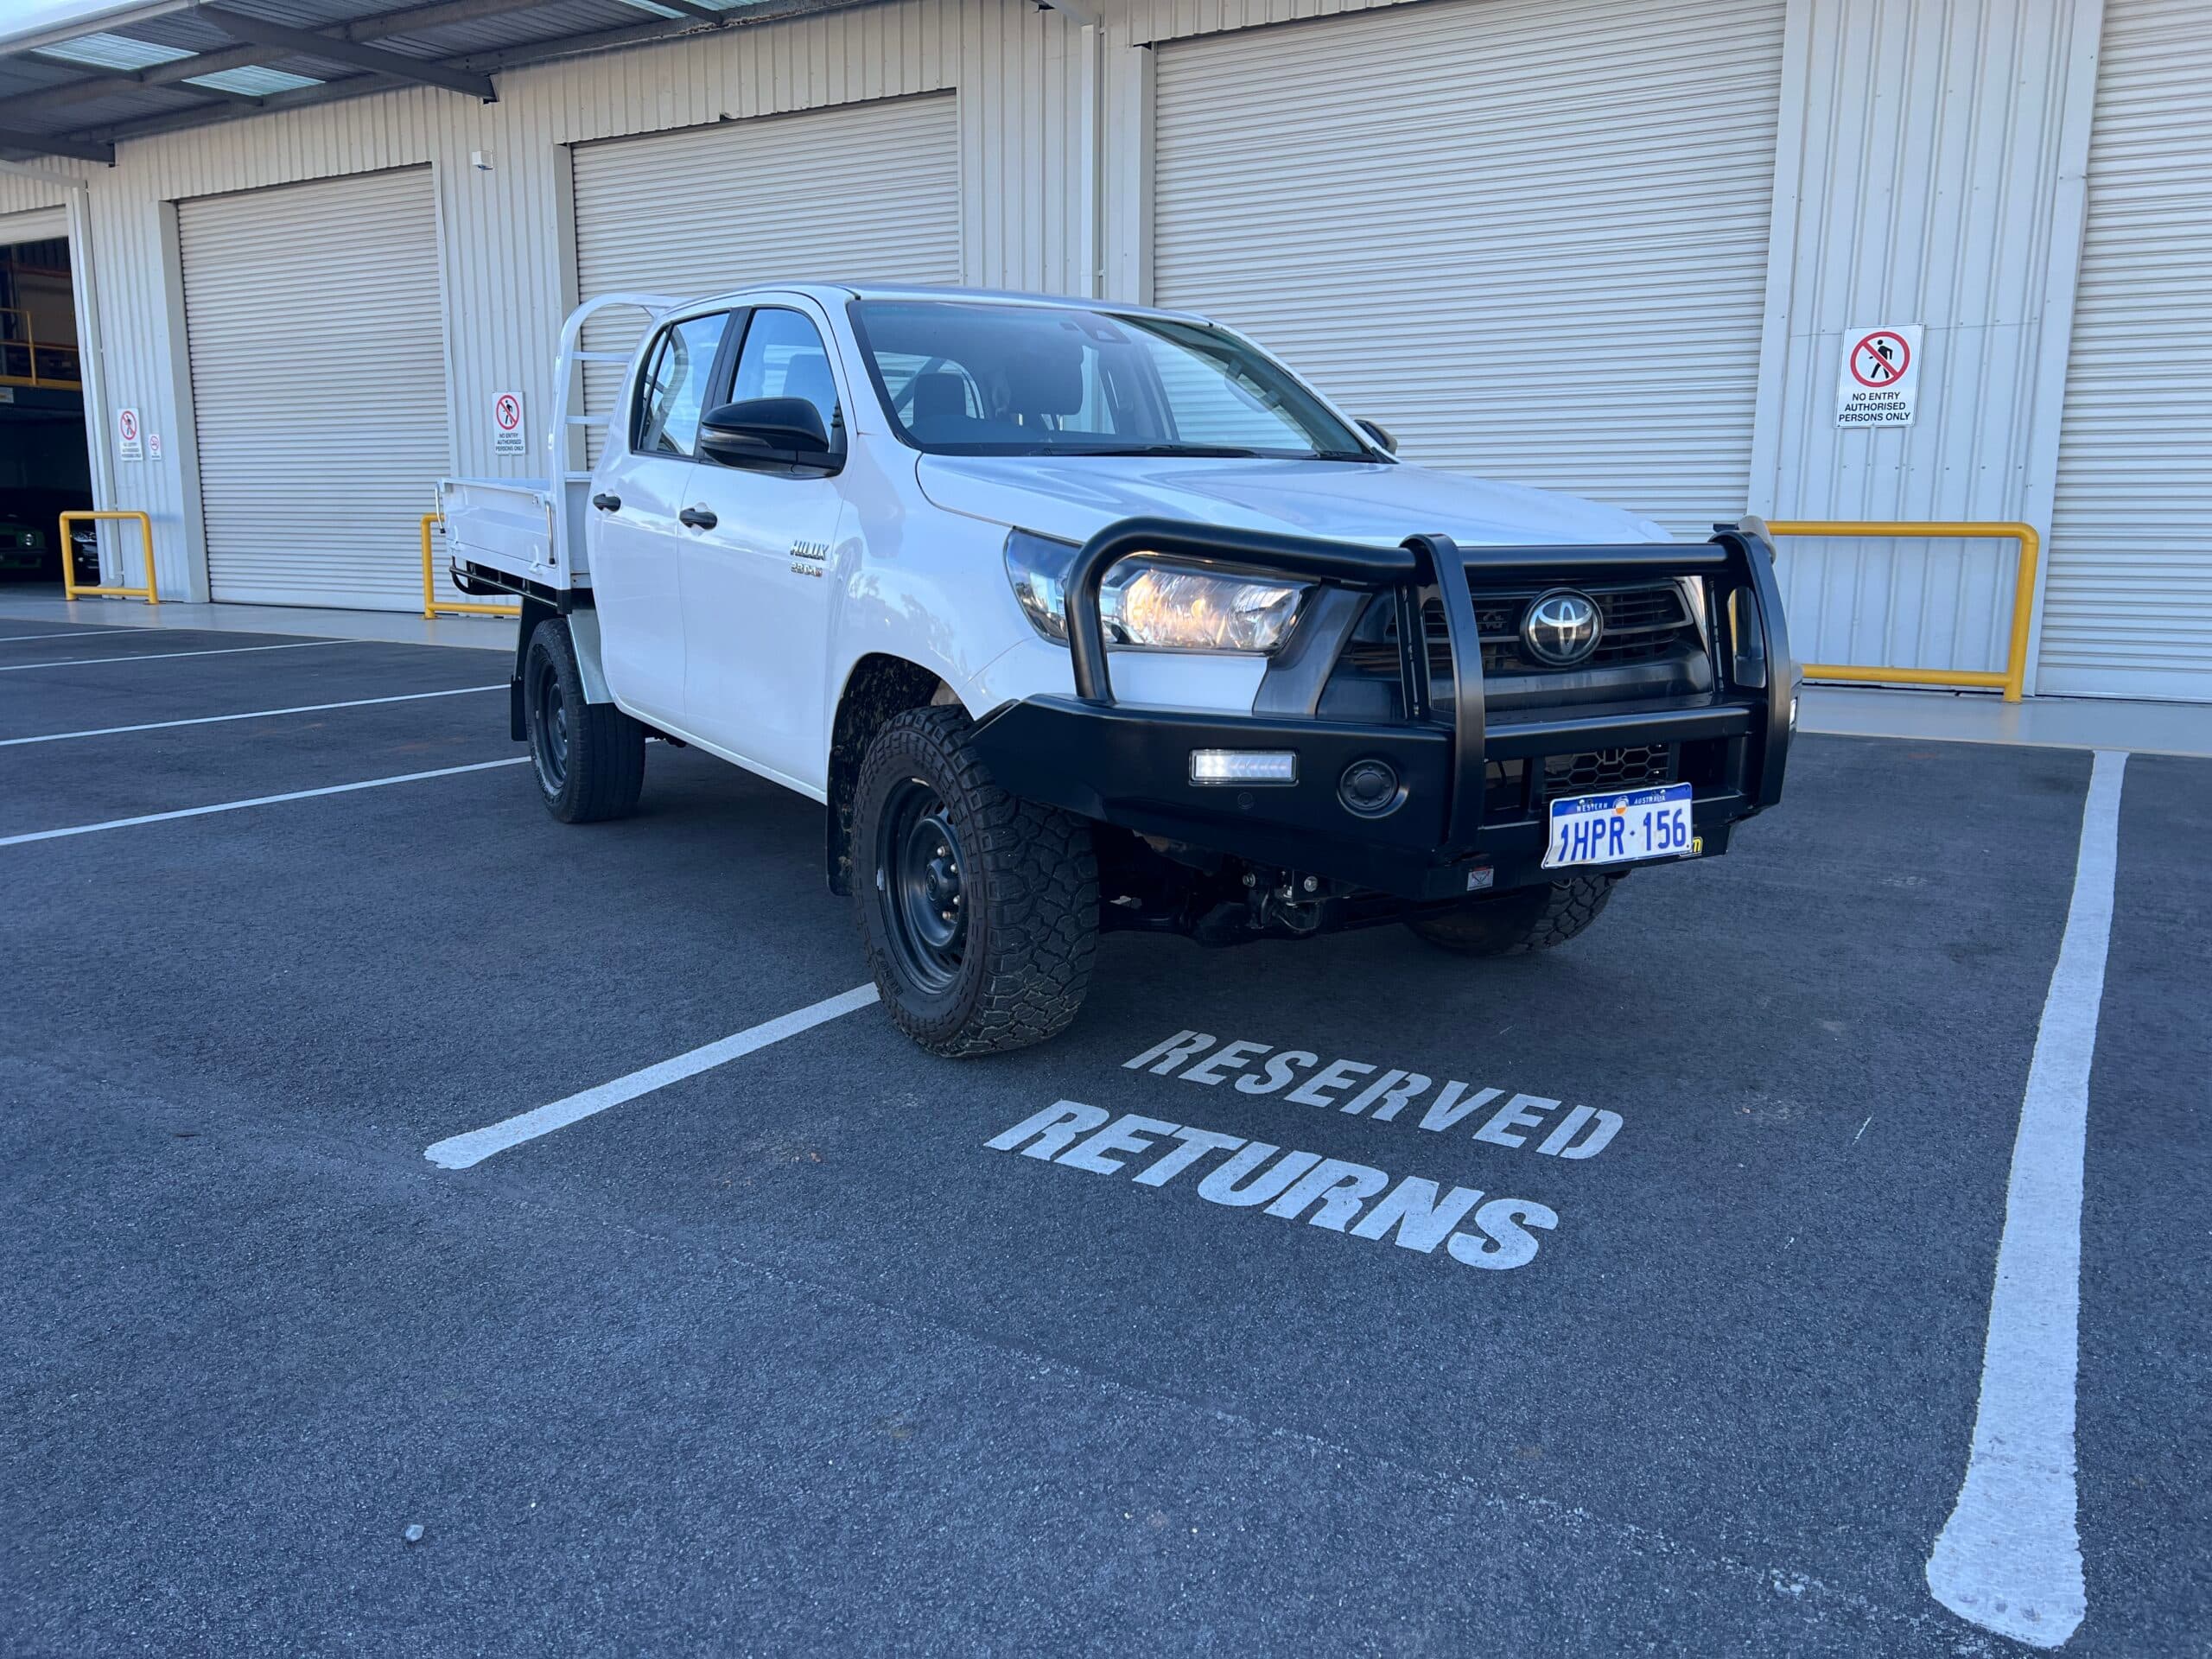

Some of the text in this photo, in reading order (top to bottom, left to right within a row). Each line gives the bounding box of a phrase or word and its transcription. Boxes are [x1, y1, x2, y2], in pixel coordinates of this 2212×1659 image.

[1852, 391, 1901, 401] NO ENTRY
[1844, 402, 1906, 412] AUTHORISED
[1838, 411, 1911, 423] PERSONS ONLY
[1576, 794, 1666, 813] WESTERN AUSTRALIA
[1122, 1029, 1624, 1160] RESERVED
[982, 1098, 1558, 1271] RETURNS
